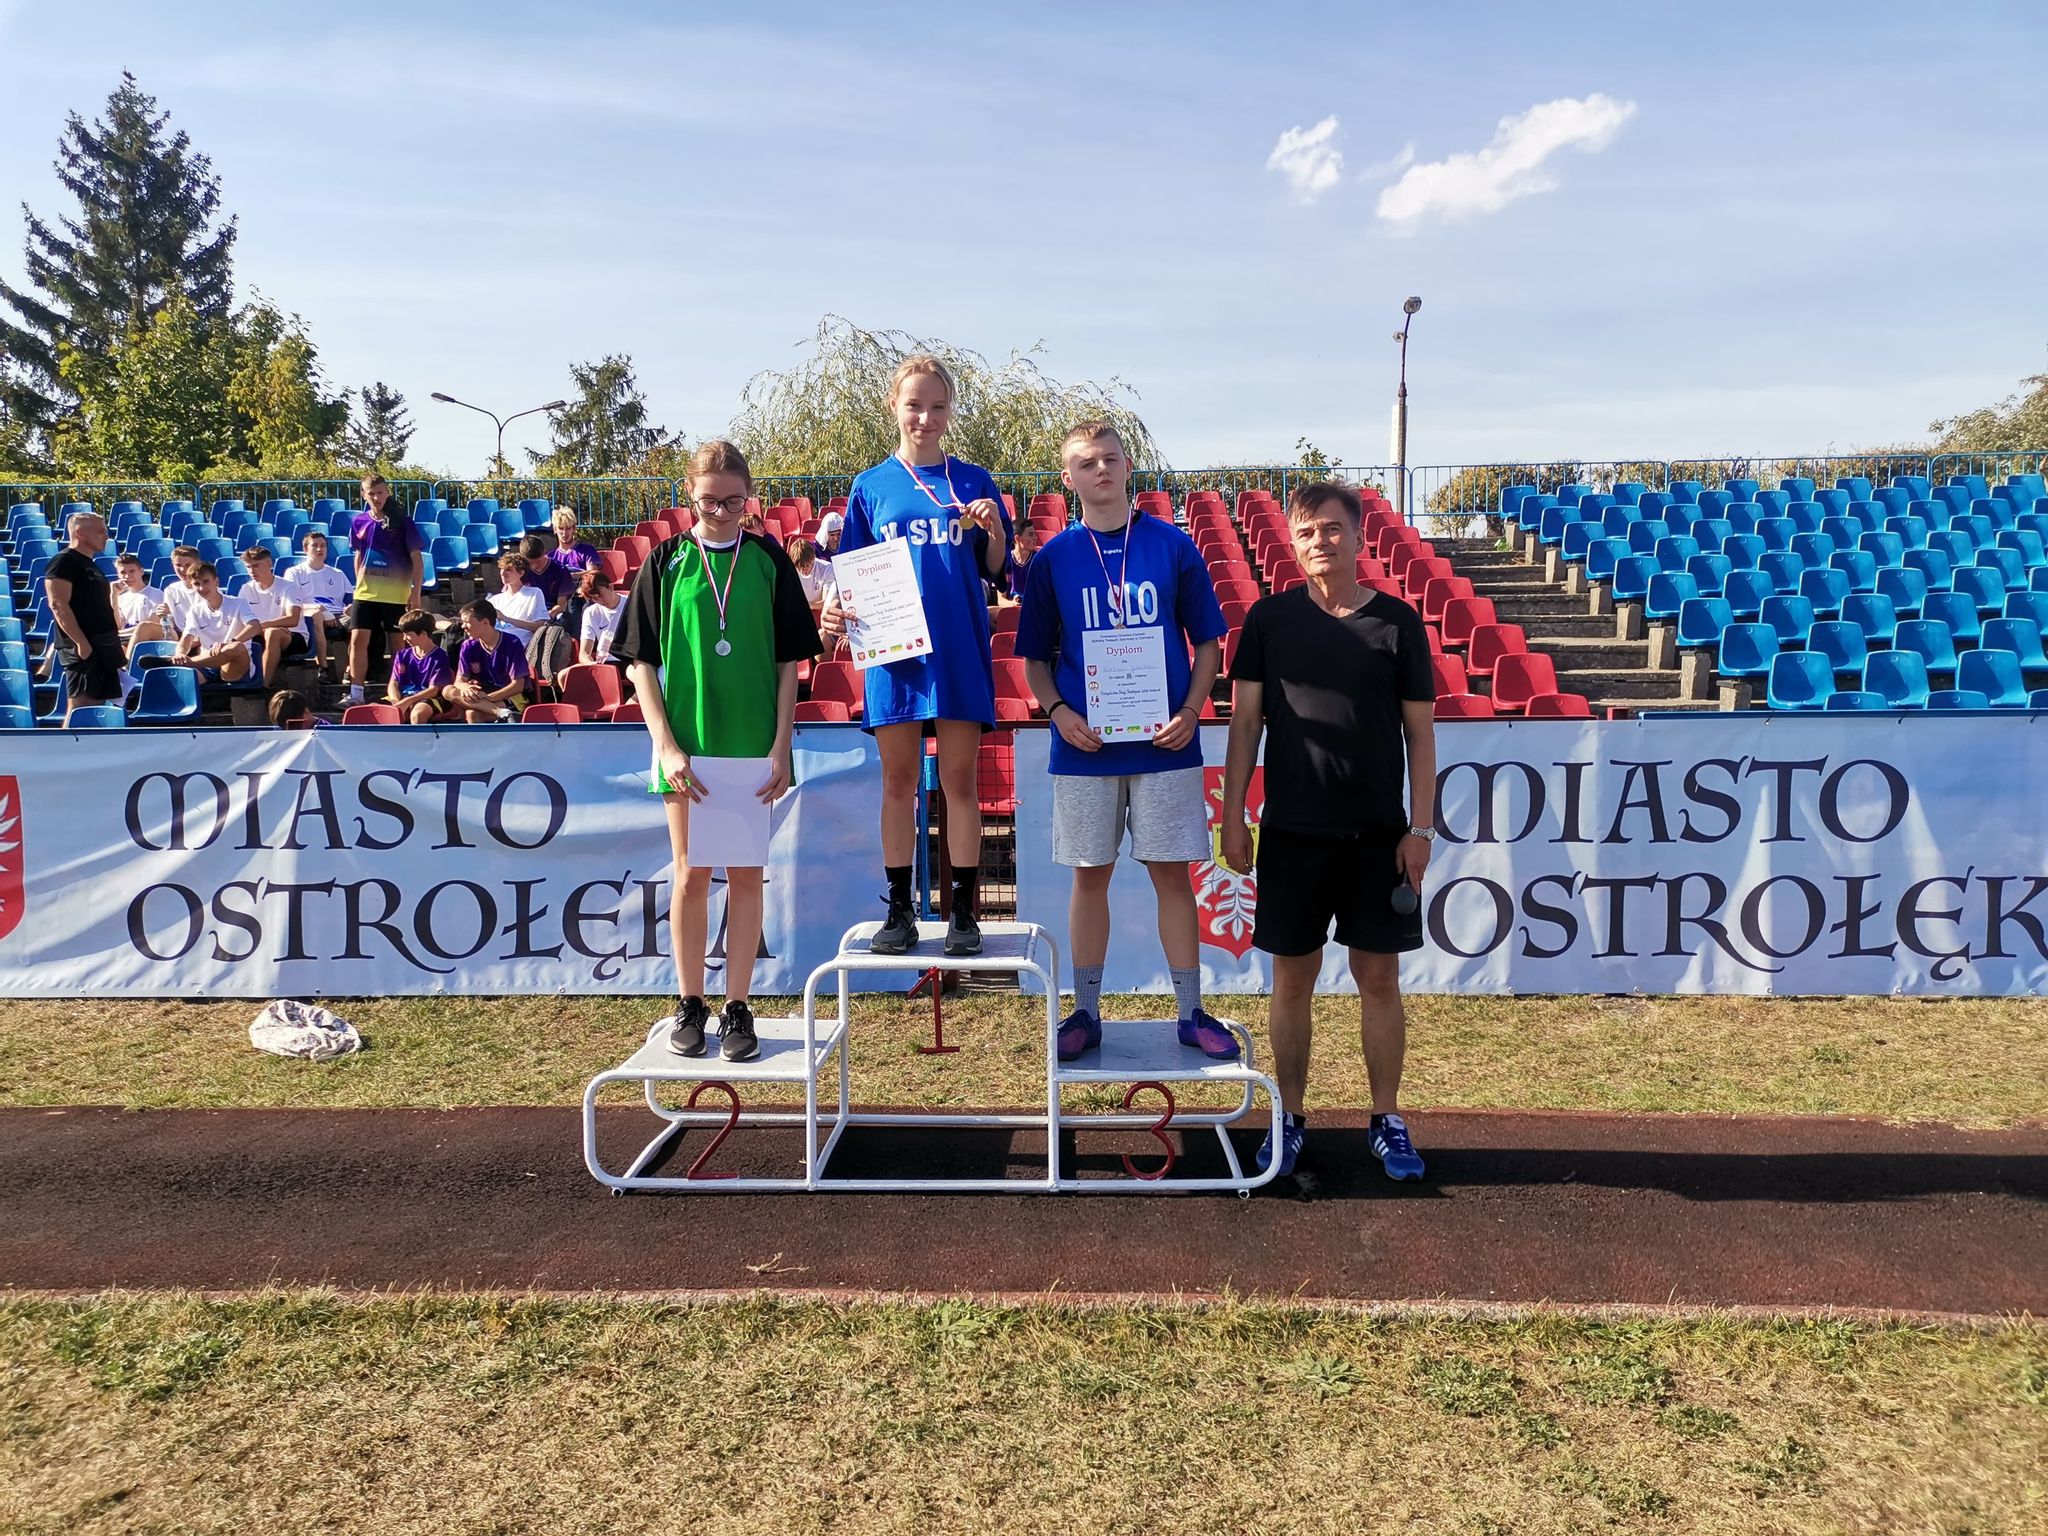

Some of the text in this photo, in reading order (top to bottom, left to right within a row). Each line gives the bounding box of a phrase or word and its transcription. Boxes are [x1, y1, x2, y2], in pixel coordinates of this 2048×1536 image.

[856, 562, 892, 577] Dyplom
[910, 518, 963, 547] SLO
[1082, 580, 1158, 629] II SLO
[1106, 646, 1143, 657] Dyplom
[124, 767, 568, 851] MIASTO
[1433, 754, 1910, 845] MIASTO
[907, 966, 960, 1055] 1
[686, 1080, 741, 1180] 2
[1121, 1081, 1175, 1181] 3
